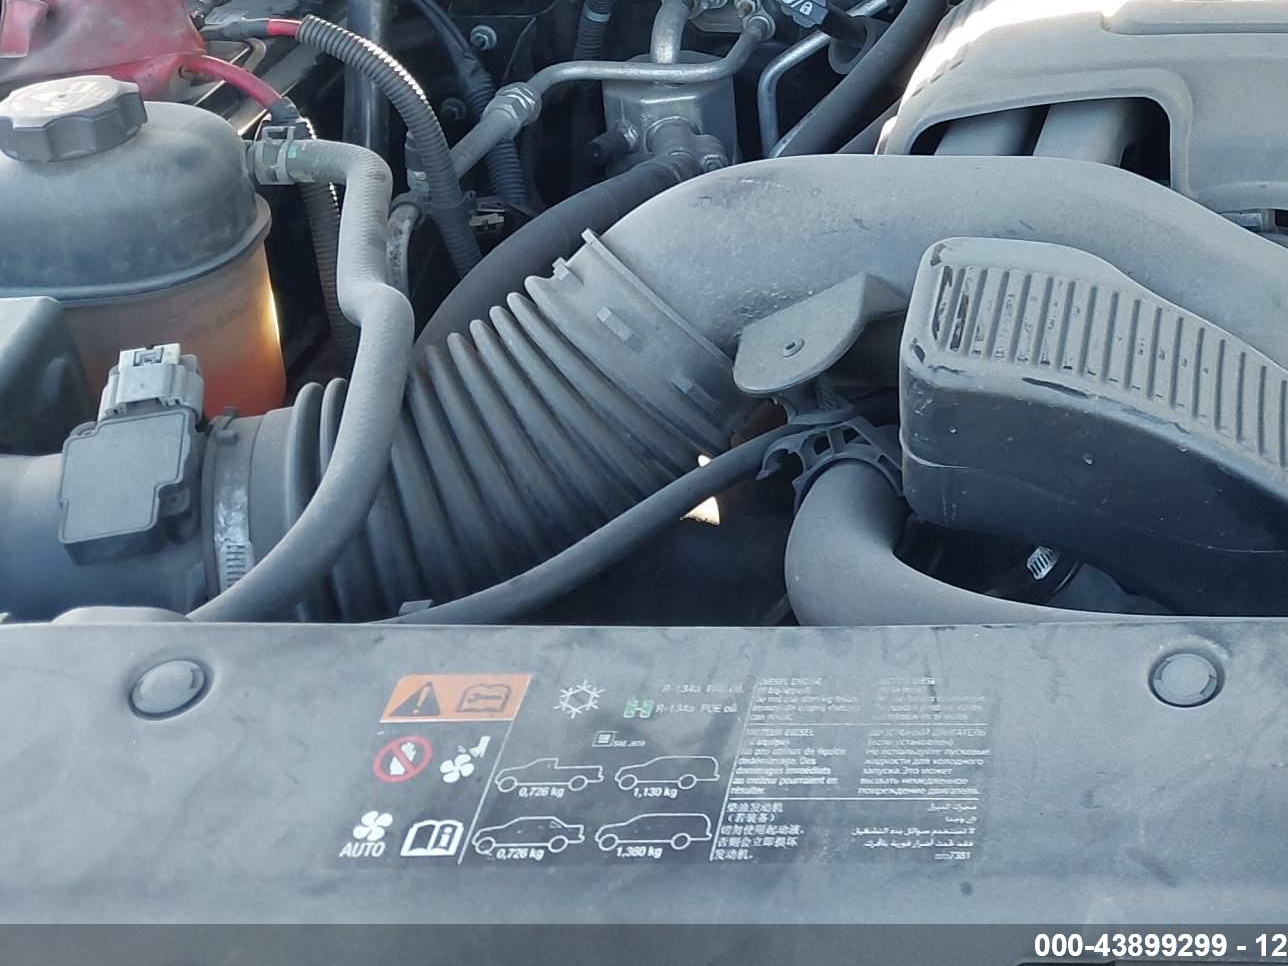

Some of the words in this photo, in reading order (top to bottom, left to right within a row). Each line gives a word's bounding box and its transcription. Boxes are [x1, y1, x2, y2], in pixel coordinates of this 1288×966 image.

[550, 786, 566, 798] kg
[633, 787, 662, 799] 1,130
[663, 787, 679, 799] kg
[339, 841, 386, 857] AUTO
[496, 848, 528, 860] 0,726
[529, 848, 545, 860] kg
[647, 845, 663, 859] kg
